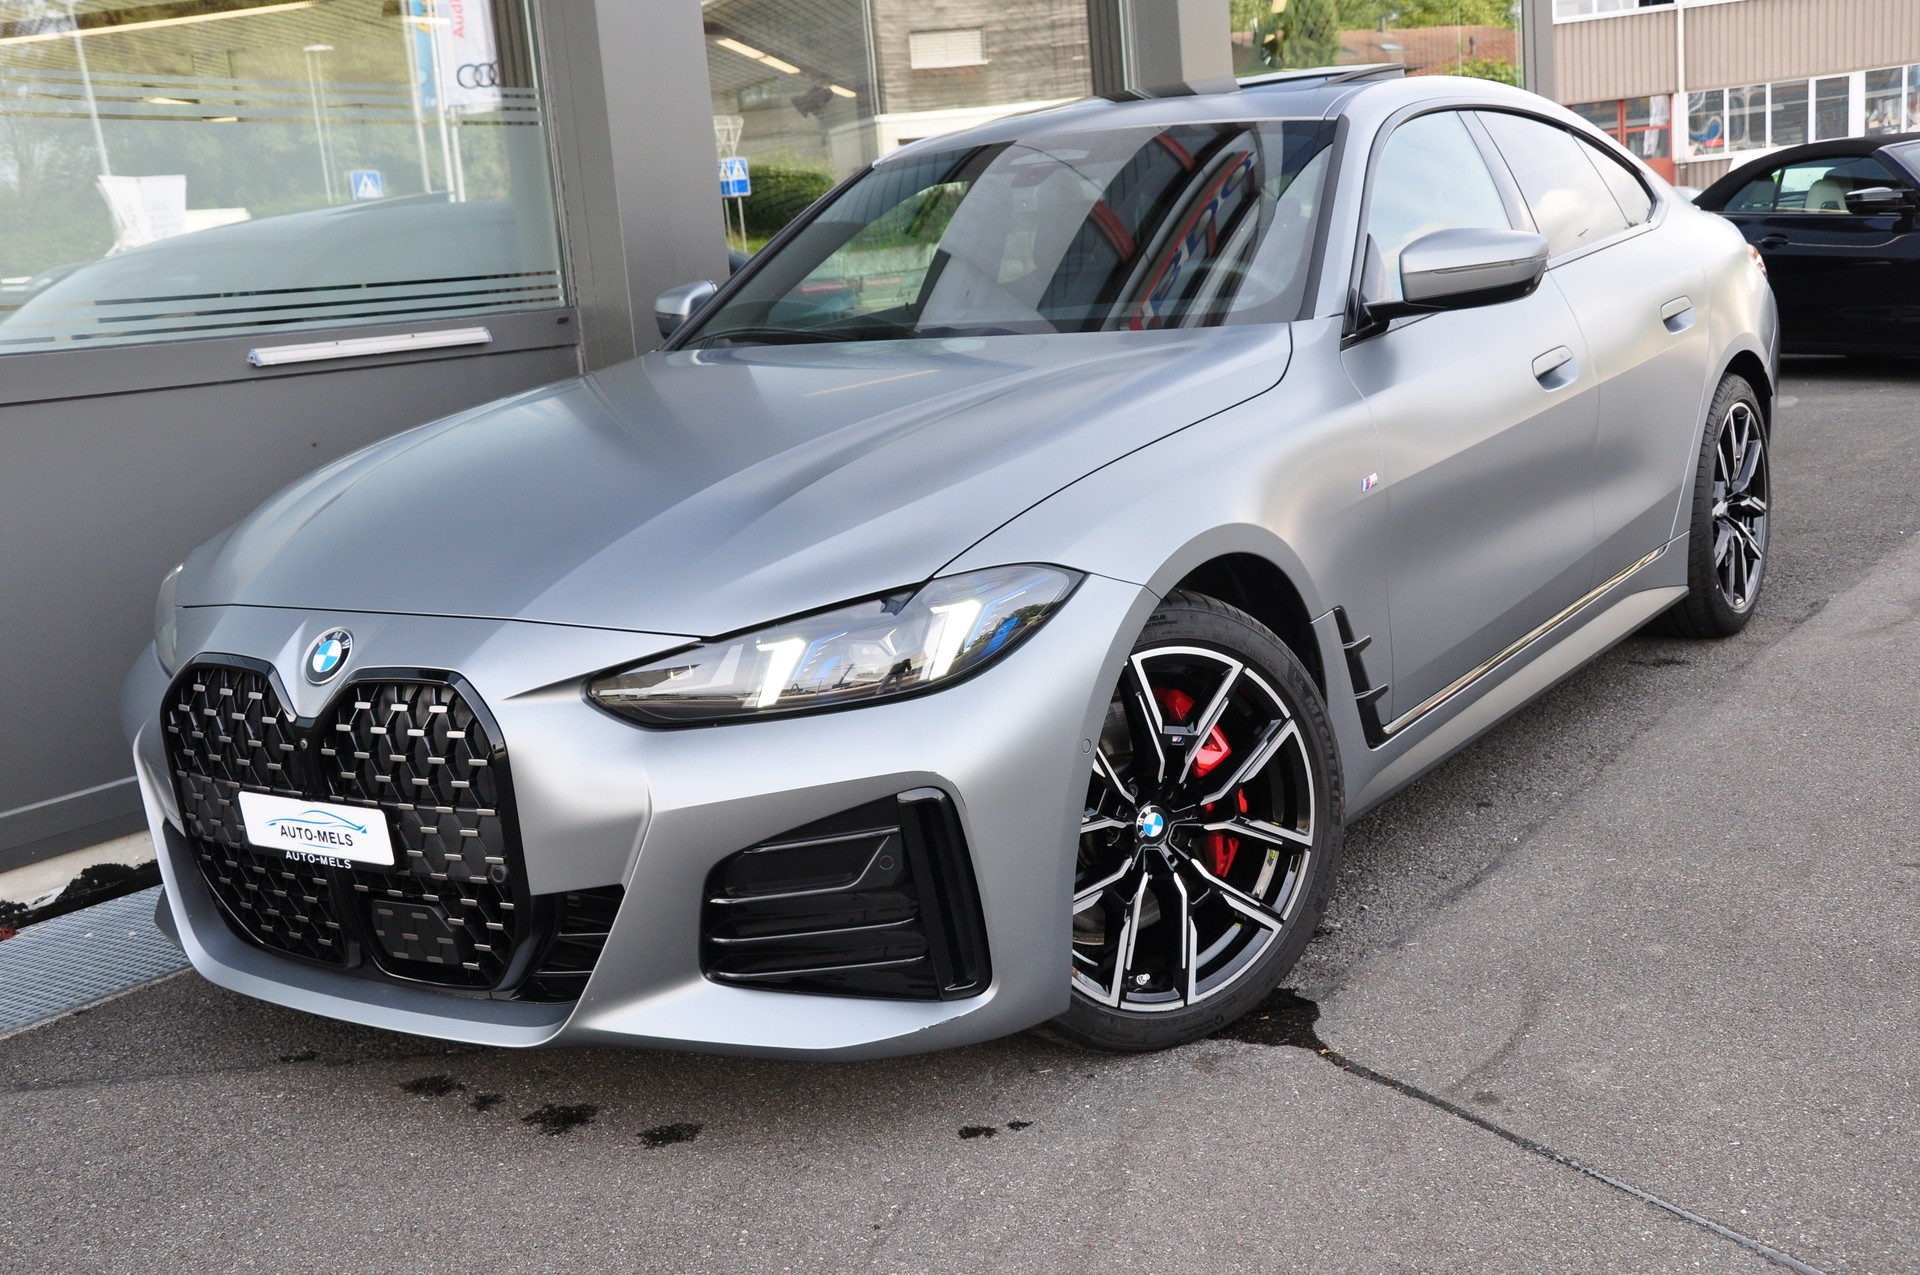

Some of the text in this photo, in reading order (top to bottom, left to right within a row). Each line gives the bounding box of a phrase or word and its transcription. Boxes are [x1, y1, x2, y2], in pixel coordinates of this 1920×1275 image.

[319, 631, 351, 650] BMW
[1306, 695, 1340, 822] MICHELIN
[280, 824, 354, 847] AUTO-MELS
[285, 850, 352, 869] AUTO-MELS
